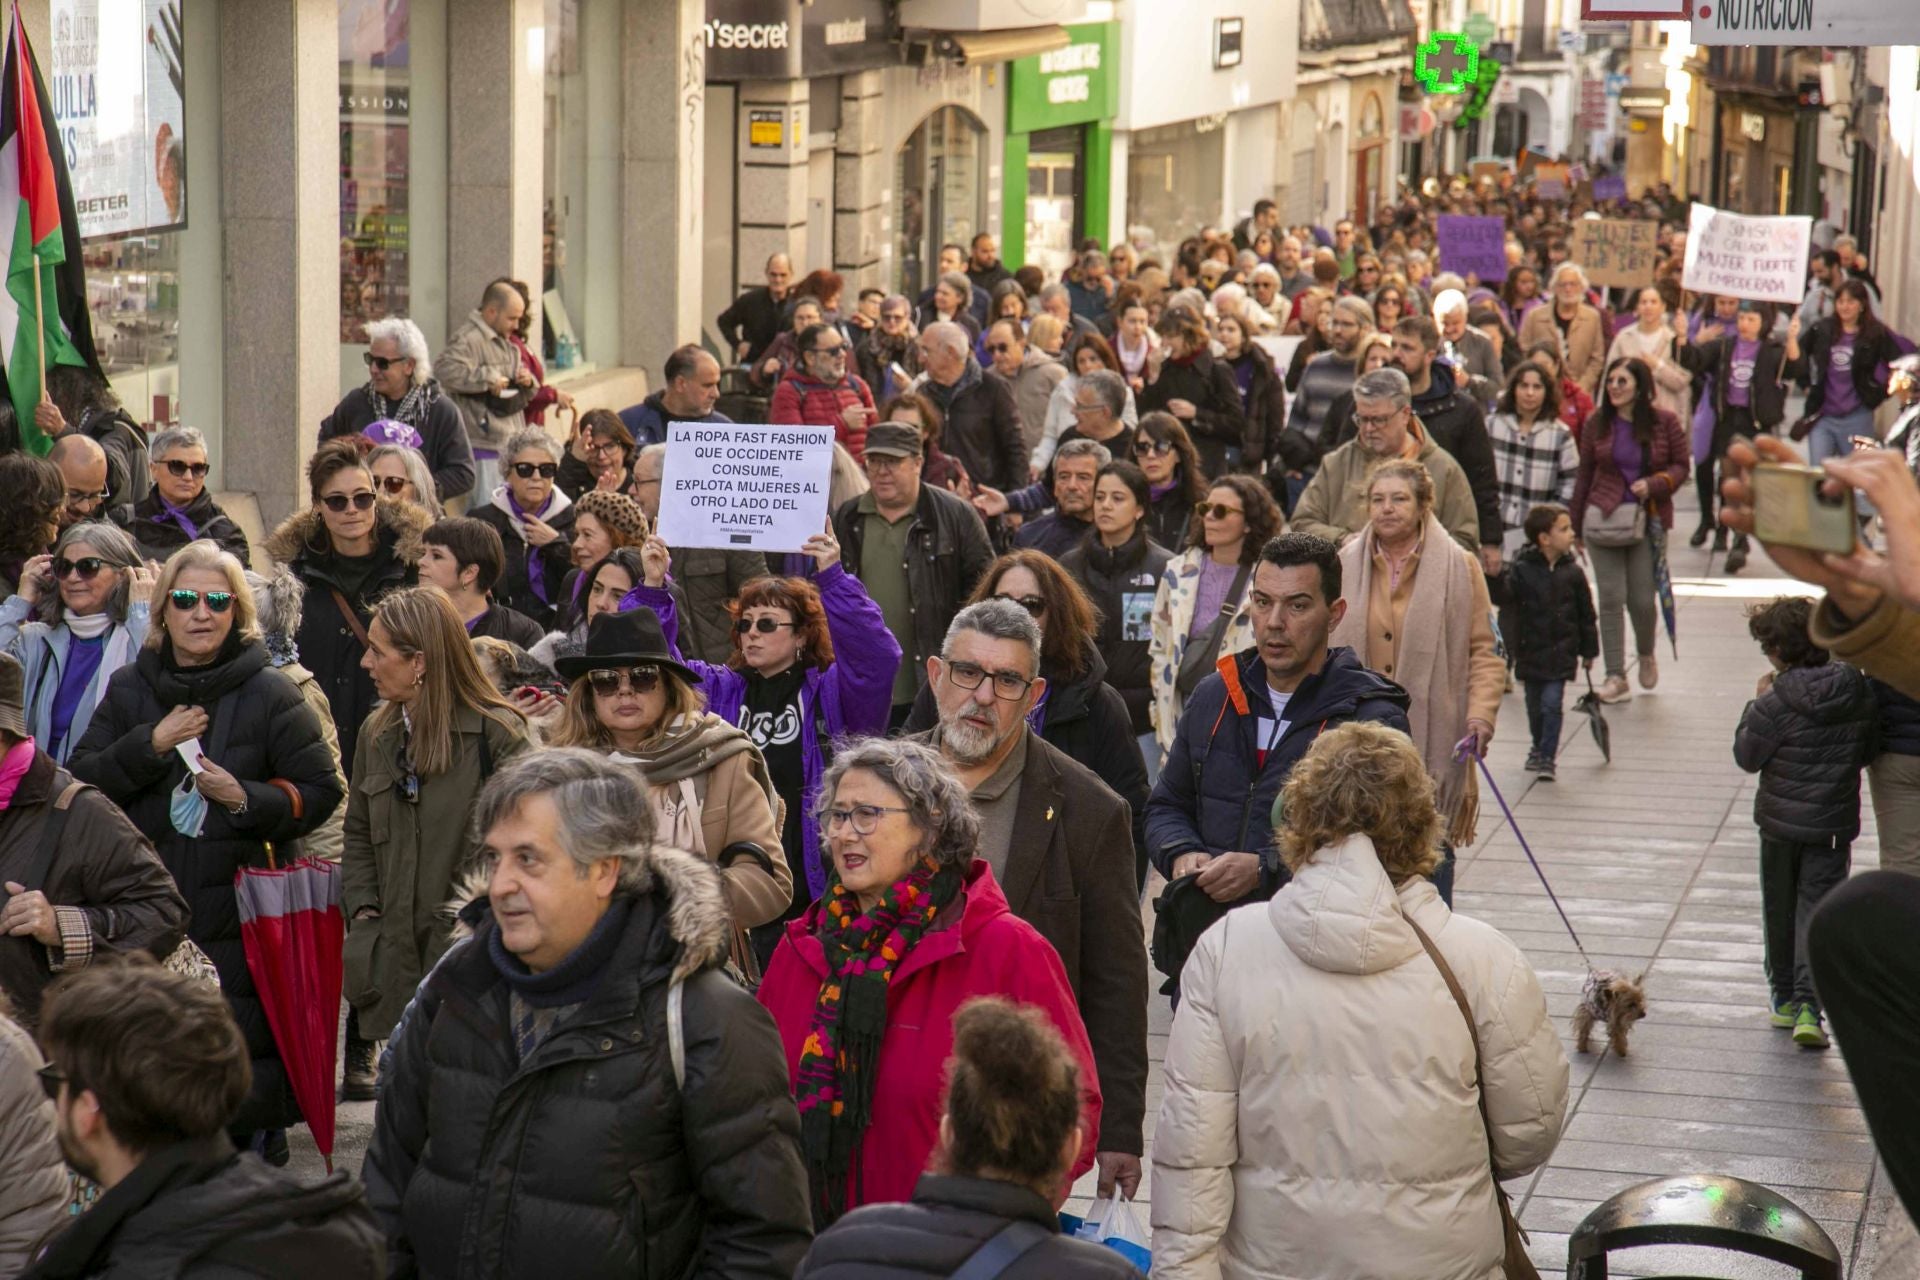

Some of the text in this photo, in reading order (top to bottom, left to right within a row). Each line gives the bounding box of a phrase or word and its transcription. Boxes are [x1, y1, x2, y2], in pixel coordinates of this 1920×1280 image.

[76, 194, 129, 213] BETER
[1695, 247, 1798, 275] MUJER FUERTE
[675, 431, 827, 445] LA ROPA FAST FASHION
[695, 447, 804, 461] QUE OCCIDENTE
[712, 464, 783, 478] CONSUME,
[675, 480, 820, 494] EXPLOTA MUJERES AL
[691, 496, 798, 510] OTRO LADO DEL
[712, 513, 774, 526] PLANETA
